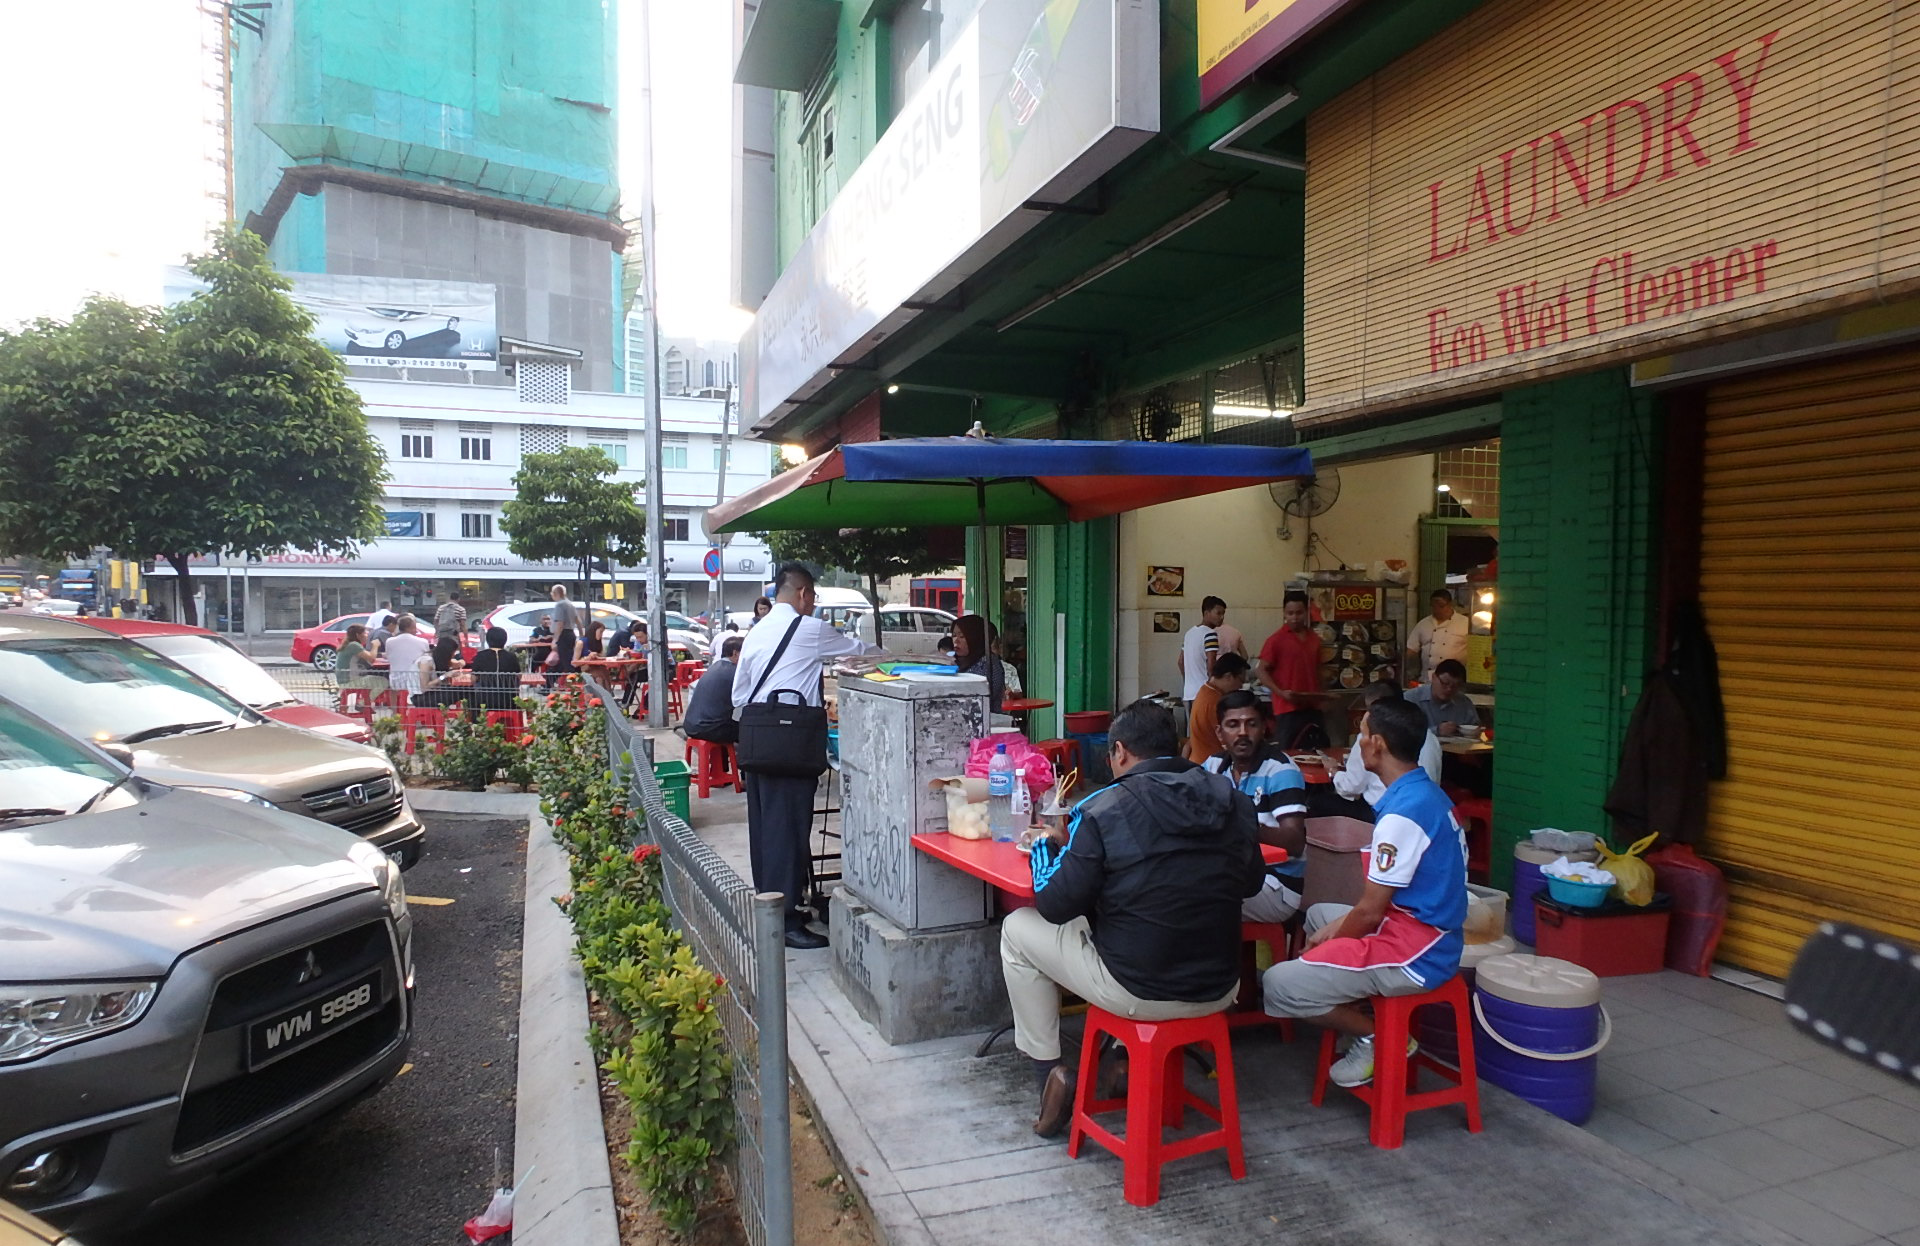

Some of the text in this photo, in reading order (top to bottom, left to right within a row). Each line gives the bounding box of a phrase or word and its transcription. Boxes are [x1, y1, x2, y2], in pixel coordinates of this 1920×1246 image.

[842, 154, 893, 252] HENG
[900, 64, 963, 196] SENG
[1428, 29, 1780, 264] LAUNDRY
[1427, 239, 1778, 373] Eco Wet Cleaner
[268, 553, 350, 564] HONDA
[438, 557, 466, 566] WAKIL
[468, 557, 509, 566] PENJUAL
[266, 983, 371, 1049] WVM 9998
